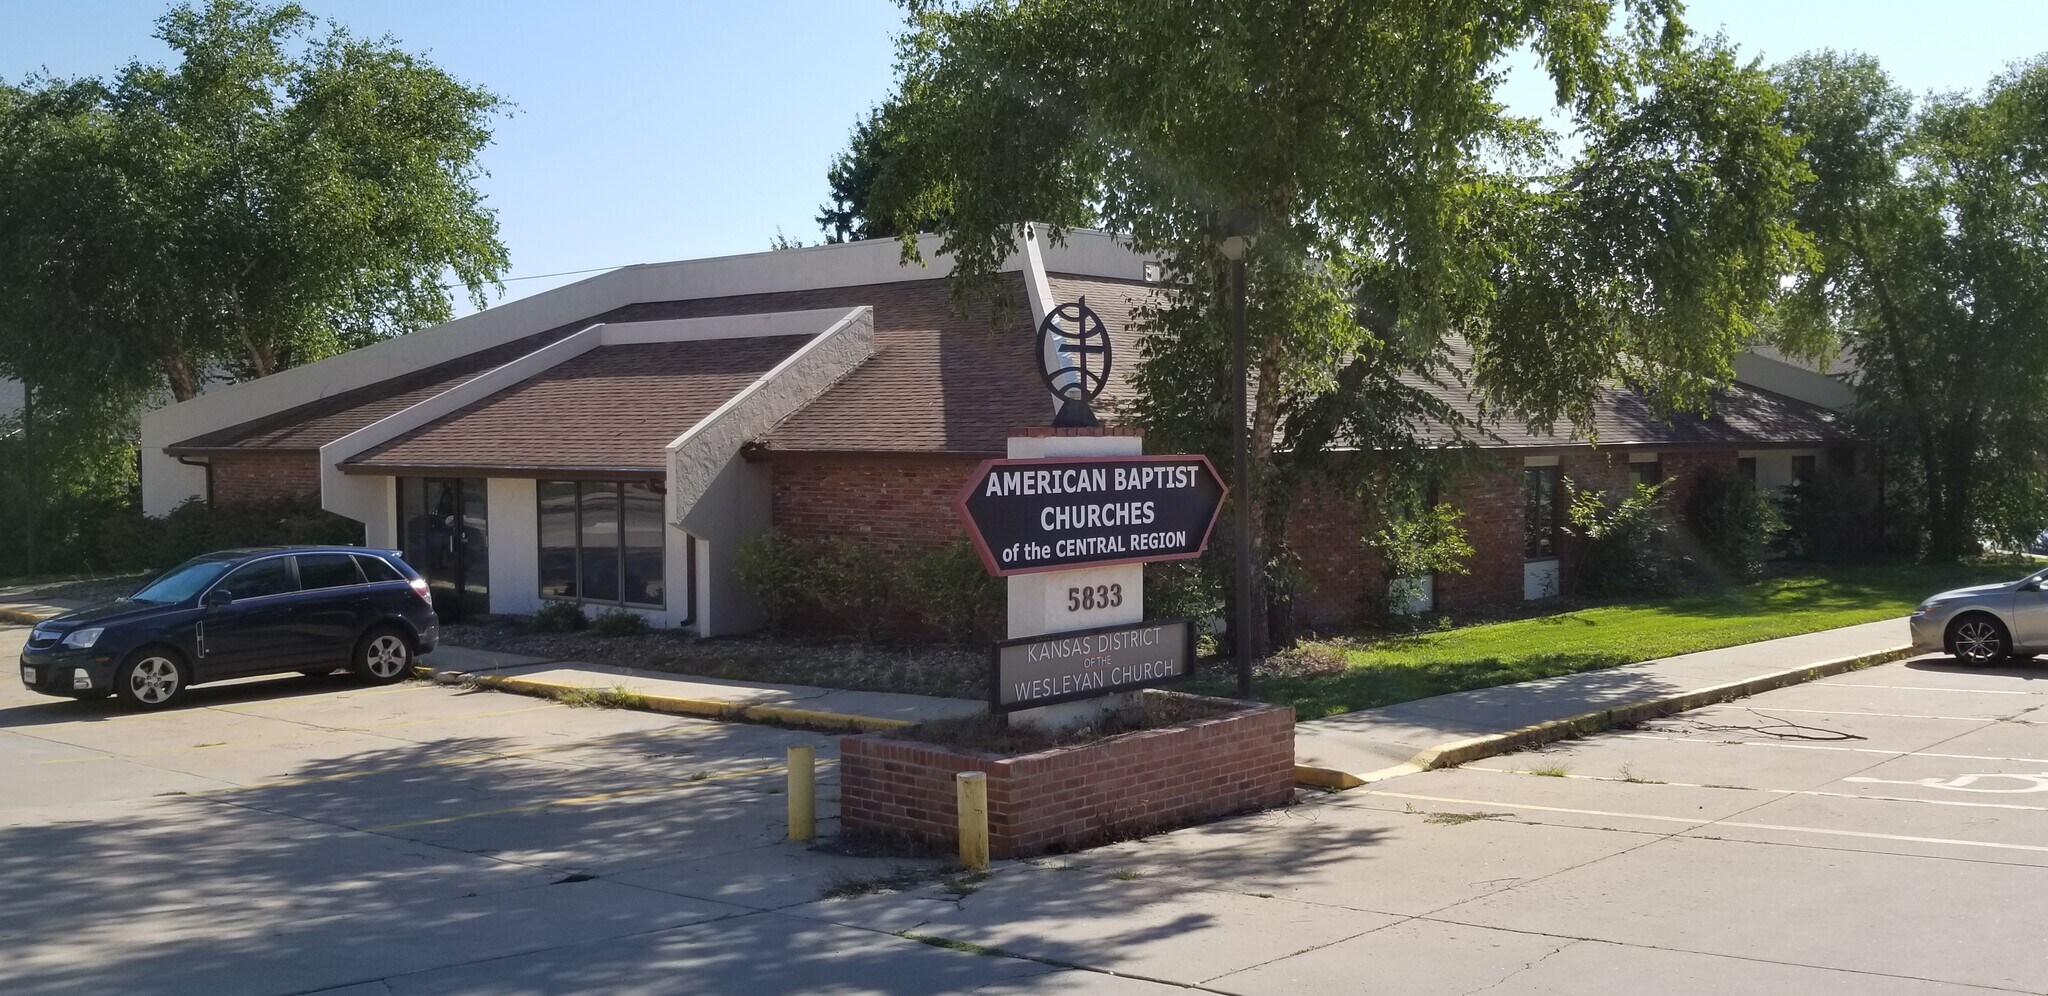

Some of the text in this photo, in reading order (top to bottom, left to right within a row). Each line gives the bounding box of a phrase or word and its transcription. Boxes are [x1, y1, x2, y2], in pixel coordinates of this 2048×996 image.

[986, 465, 1199, 497] AMERICAN BAPTIST
[1040, 501, 1155, 531] CHURCHES
[1002, 530, 1186, 563] of the CENTRAL REGION
[1068, 583, 1123, 612] 5833
[1027, 627, 1162, 663] KANSAS DISTRICT
[1084, 655, 1112, 668] OF THE
[1015, 659, 1174, 702] WESLEYAN CHURCH
